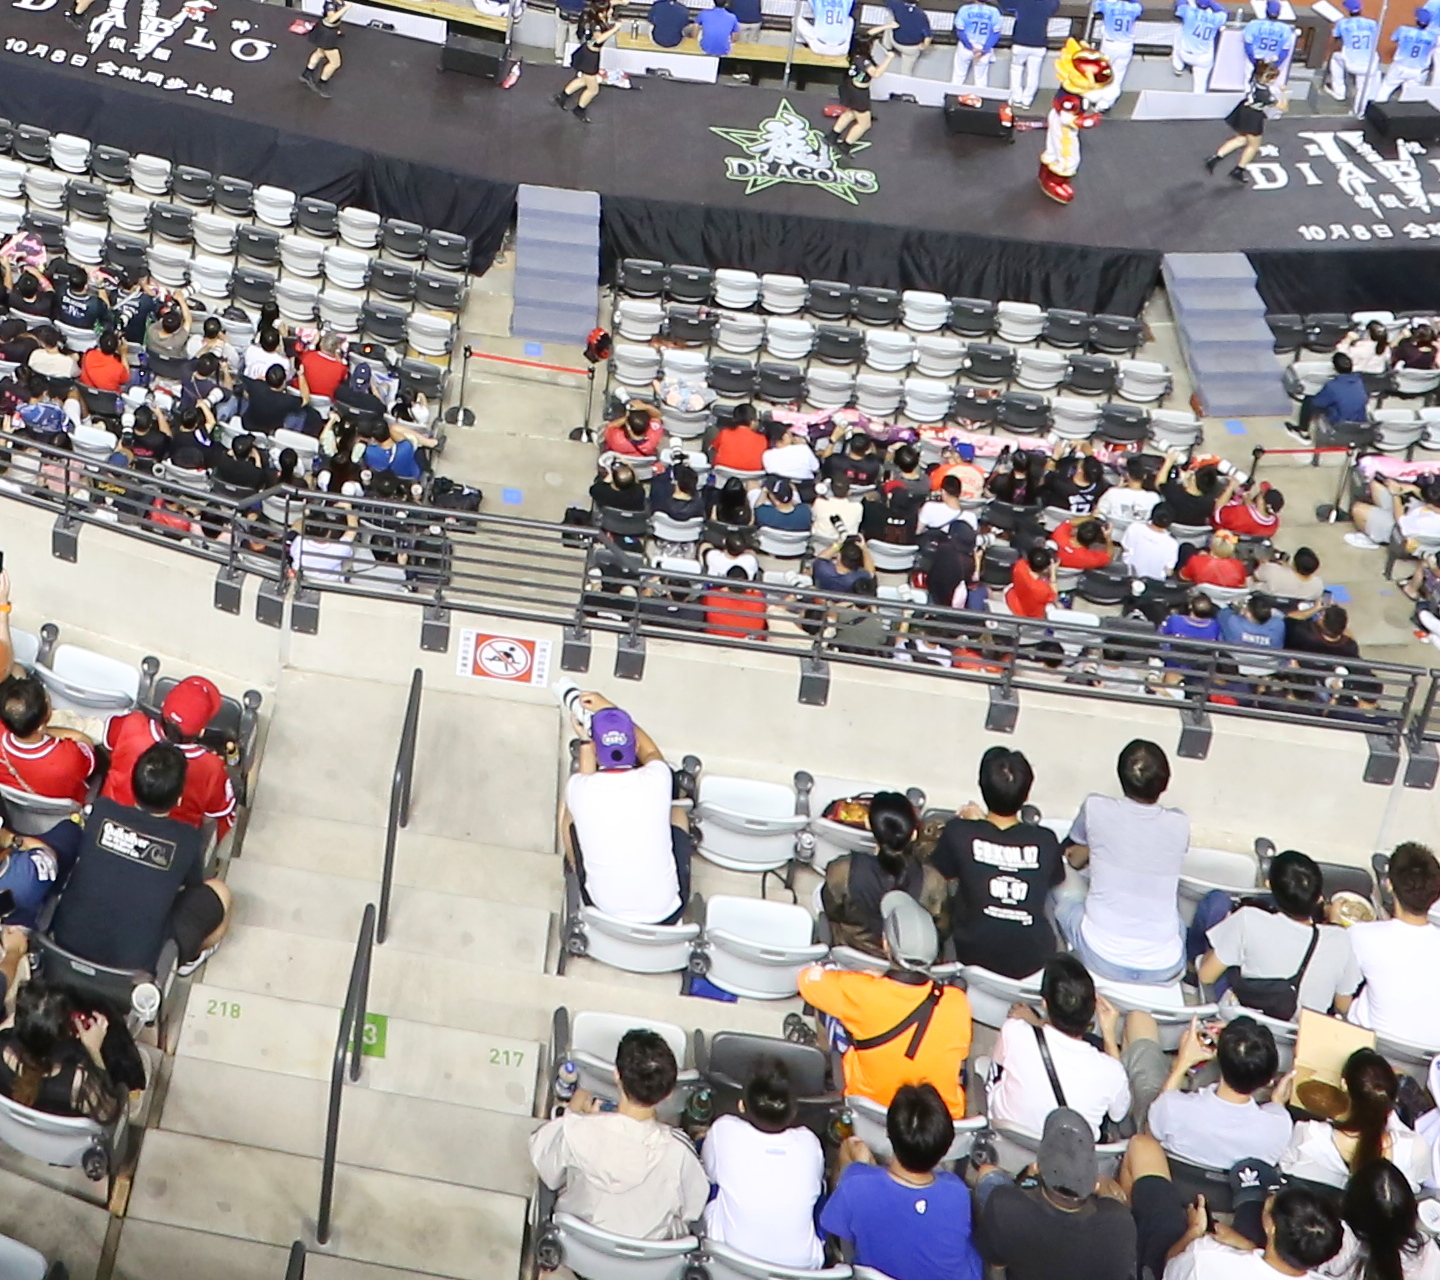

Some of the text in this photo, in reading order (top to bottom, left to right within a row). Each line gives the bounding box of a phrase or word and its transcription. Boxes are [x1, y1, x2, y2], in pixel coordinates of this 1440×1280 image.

[825, 8, 844, 26] 84
[1113, 18, 1131, 33] 91
[971, 20, 988, 35] 72
[1192, 26, 1212, 40] 40
[1259, 37, 1278, 52] 52
[1352, 35, 1370, 50] 27
[4, 37, 234, 105] 10月8日 全球同步上線
[730, 159, 877, 189] DRAGONS
[1297, 223, 1394, 241] 10月8日
[207, 999, 242, 1020] 218
[489, 1046, 525, 1067] 217
